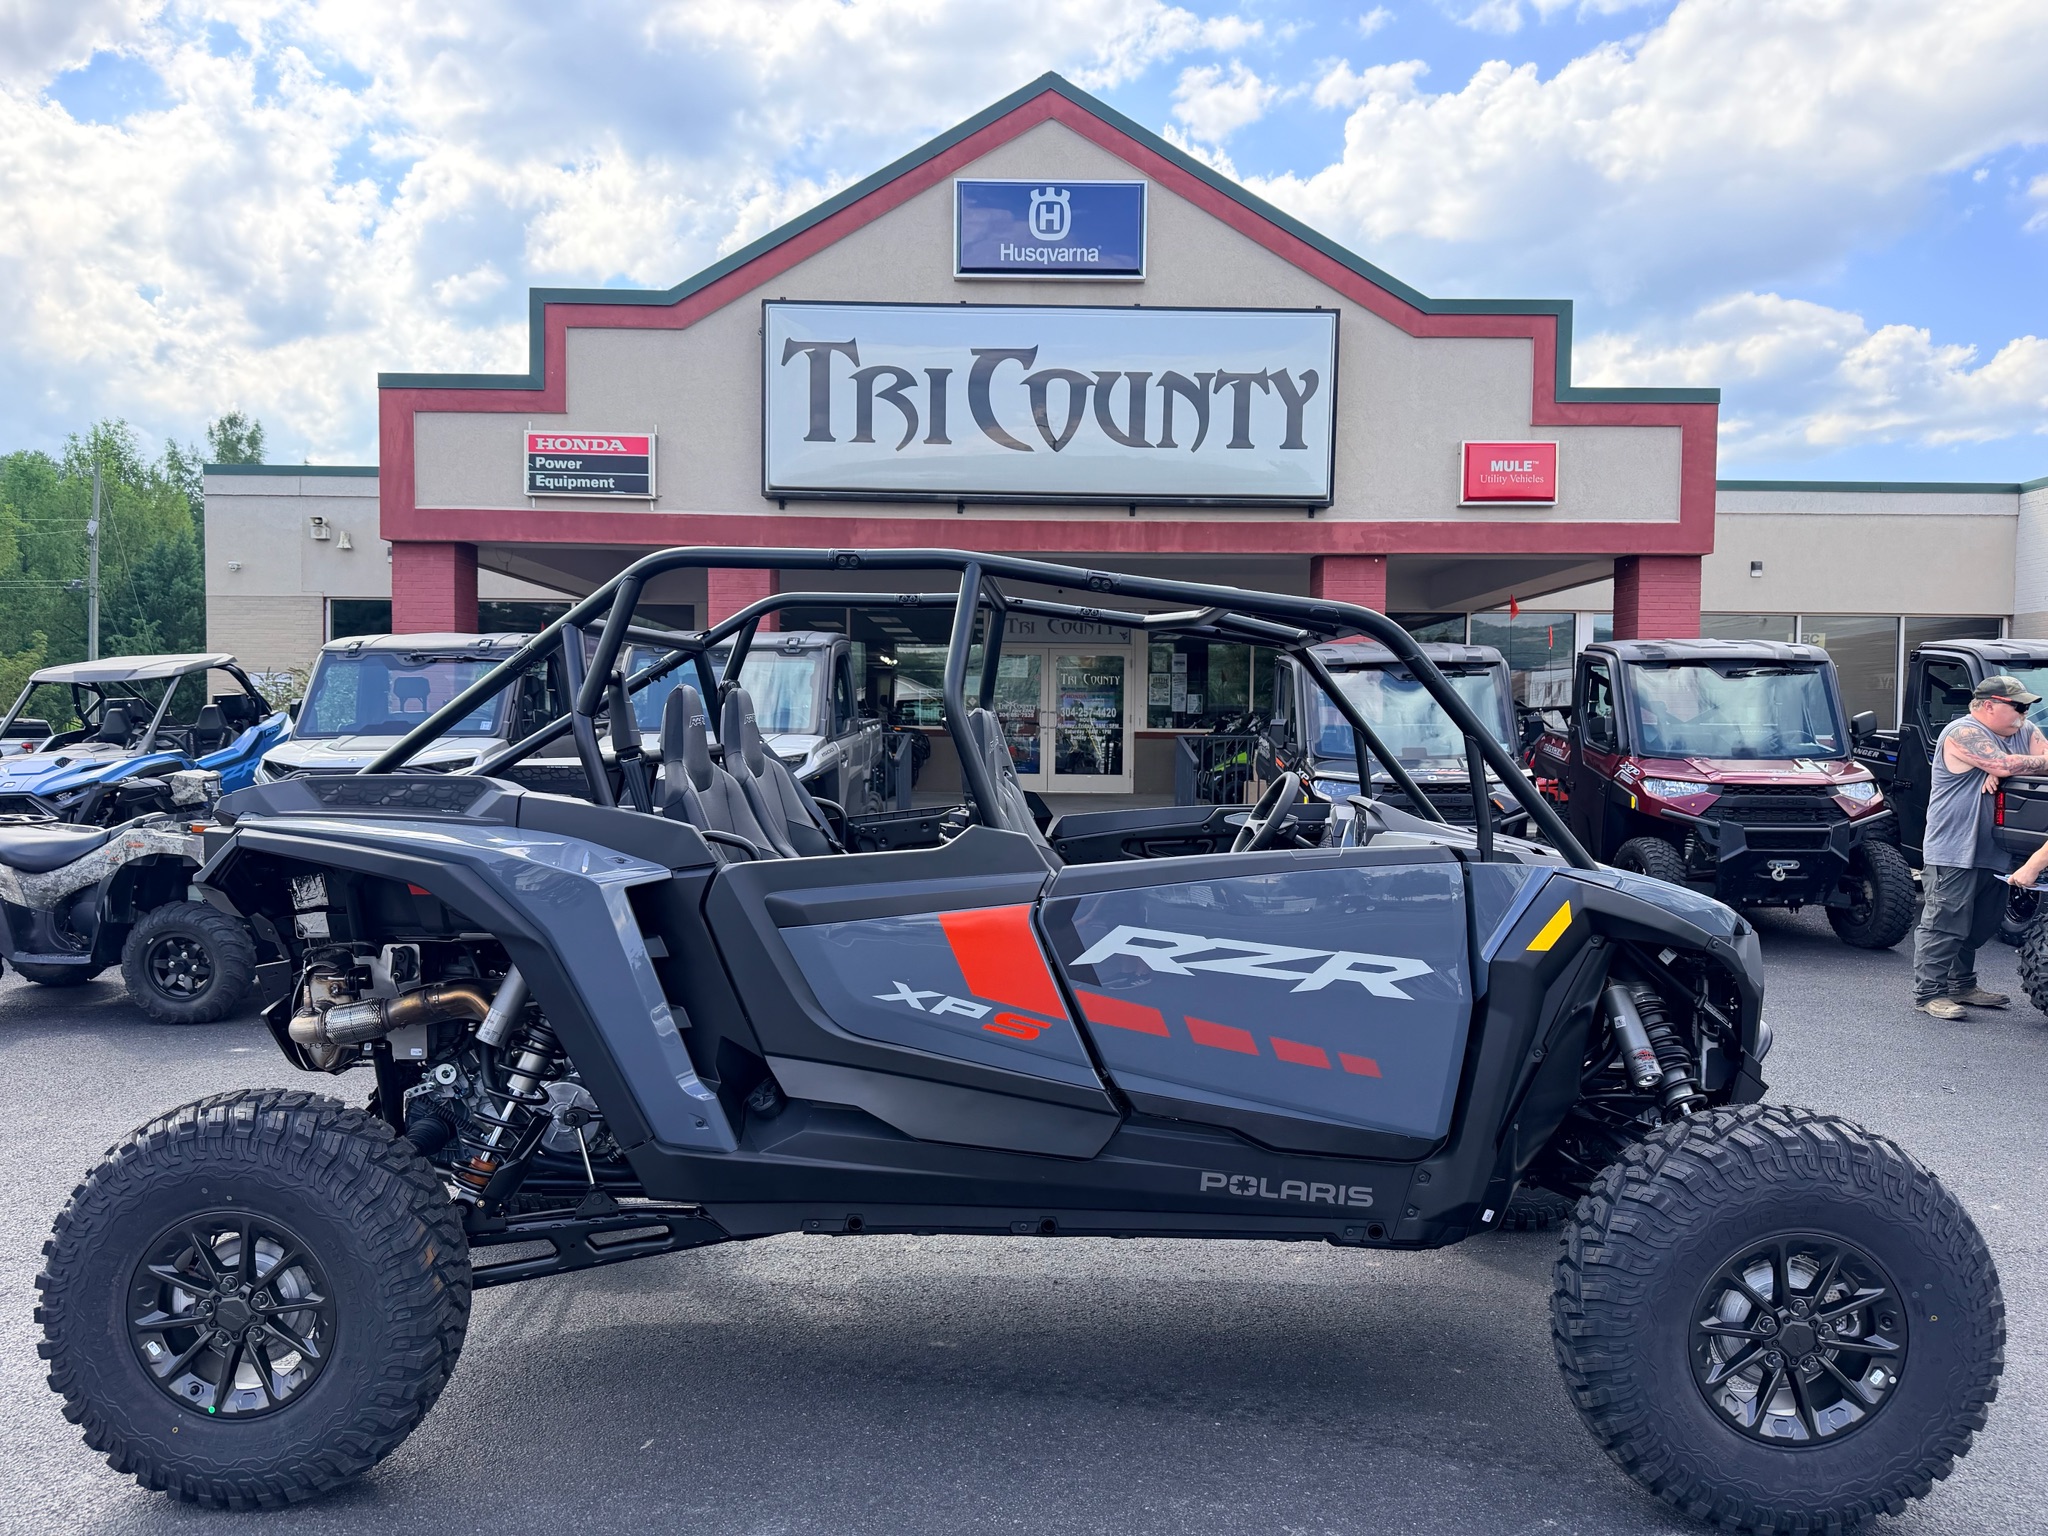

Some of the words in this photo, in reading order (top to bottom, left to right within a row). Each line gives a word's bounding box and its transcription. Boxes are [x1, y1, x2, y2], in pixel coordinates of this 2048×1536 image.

[999, 242, 1099, 265] Husqvarna
[780, 336, 953, 452] TRI
[967, 343, 1320, 453] COUNTY
[535, 437, 627, 452] HONDA
[535, 456, 583, 470] Power
[535, 474, 615, 489] Equipment
[1480, 474, 1508, 485] Utility
[1510, 474, 1545, 484] Vehicles
[1006, 617, 1035, 635] TRI
[1060, 673, 1077, 685] TRI
[1083, 673, 1121, 686] COUNTY
[1060, 707, 1117, 718] 304-257-4420
[1853, 747, 1880, 758] ANGER
[221, 757, 260, 782] ZR
[1619, 760, 1640, 776] XP
[1068, 924, 1435, 1001] RZR
[1200, 1169, 1375, 1208] POLARIS
